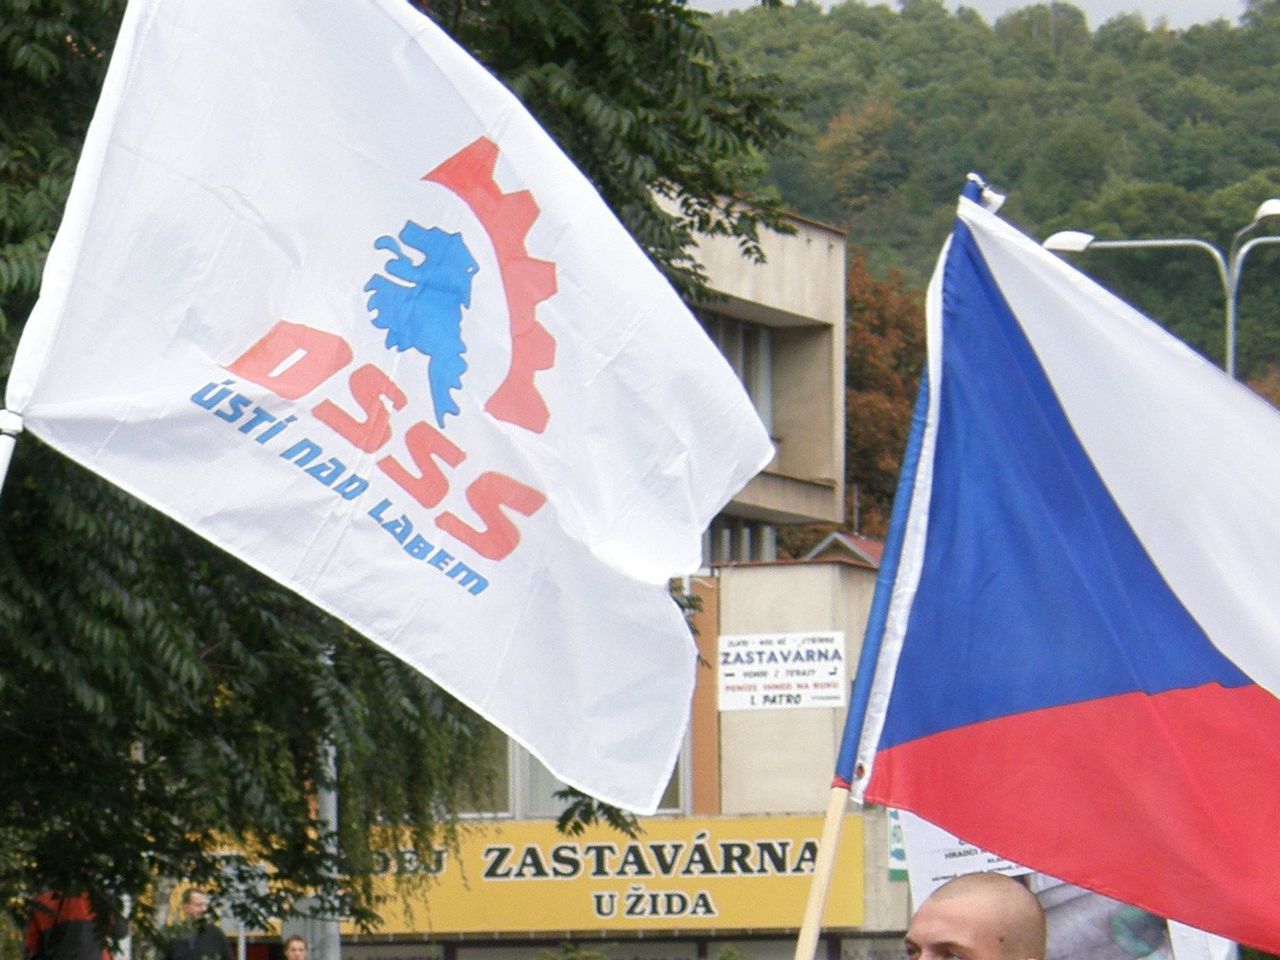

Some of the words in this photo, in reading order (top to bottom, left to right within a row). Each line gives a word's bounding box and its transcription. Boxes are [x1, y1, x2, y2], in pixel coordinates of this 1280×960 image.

[190, 379, 297, 444] ÚSTÍ
[221, 320, 547, 561] DSSS
[483, 832, 819, 879] ZASTAVÁRNA
[593, 893, 616, 916] U
[625, 885, 716, 916] ŽIDA
